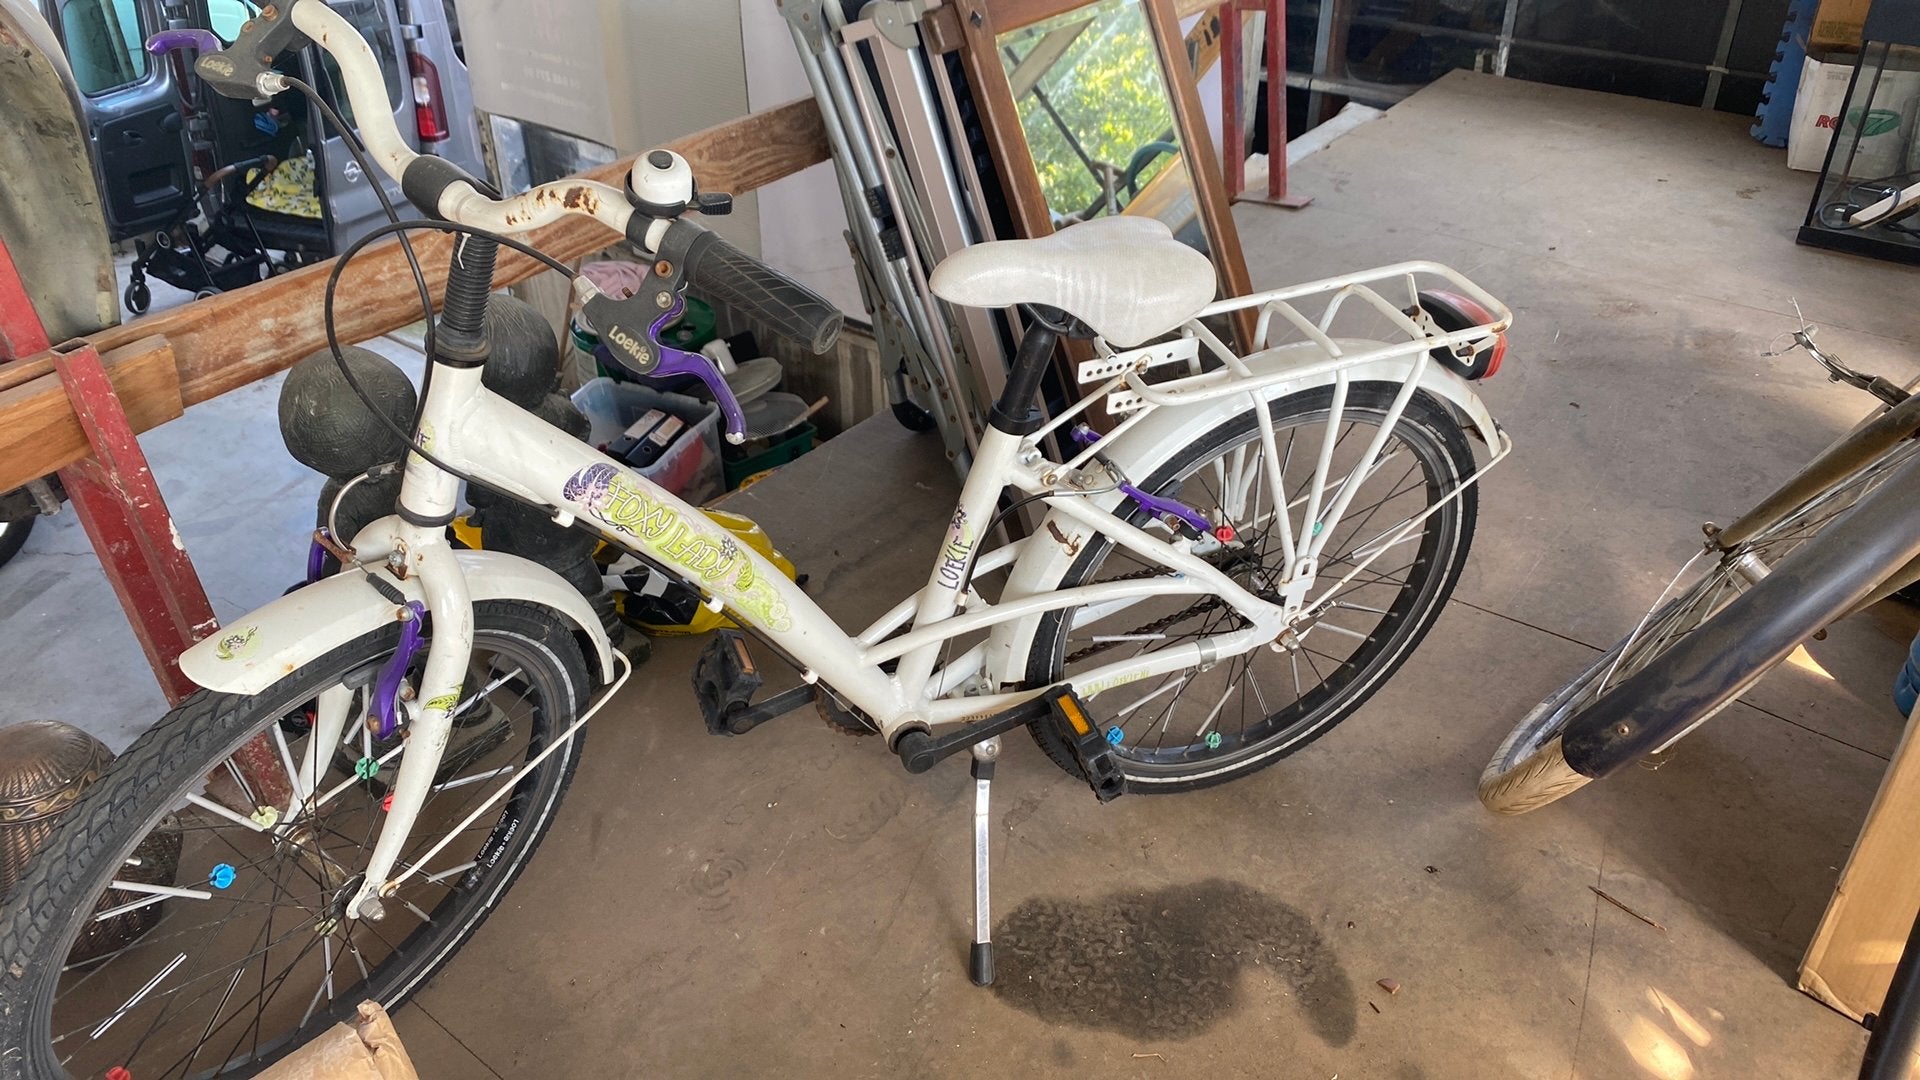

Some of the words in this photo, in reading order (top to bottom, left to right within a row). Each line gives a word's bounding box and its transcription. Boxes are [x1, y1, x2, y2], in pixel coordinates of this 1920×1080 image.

[608, 325, 651, 365] Loekie
[606, 480, 675, 539] FOXY
[659, 526, 735, 580] LADY
[937, 536, 974, 590] LOEKIE
